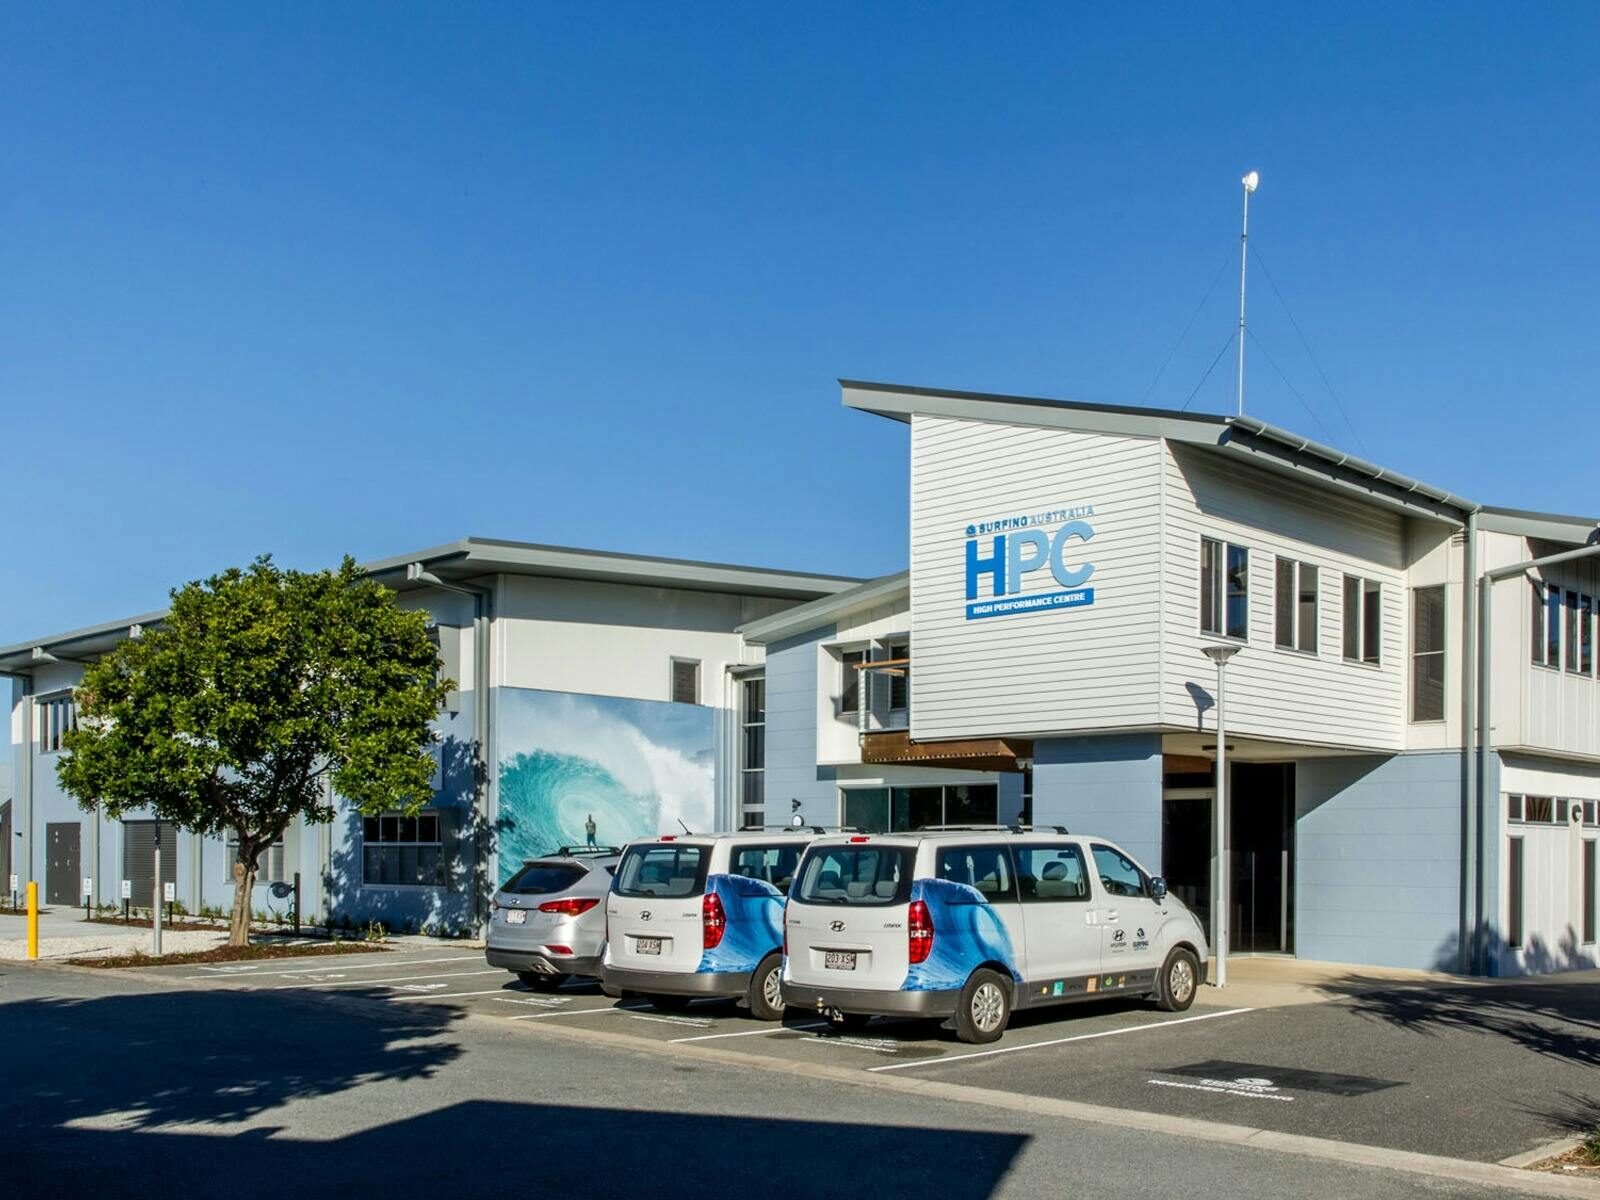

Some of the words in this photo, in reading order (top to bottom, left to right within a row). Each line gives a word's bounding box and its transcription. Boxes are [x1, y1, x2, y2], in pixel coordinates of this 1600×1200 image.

[979, 516, 1028, 534] SURFING
[1030, 505, 1095, 526] AUSTRALIA
[966, 520, 1095, 600] HPC
[973, 604, 993, 615] HIGH
[994, 597, 1053, 612] PERFORMANCE
[1053, 592, 1086, 605] CENTRE
